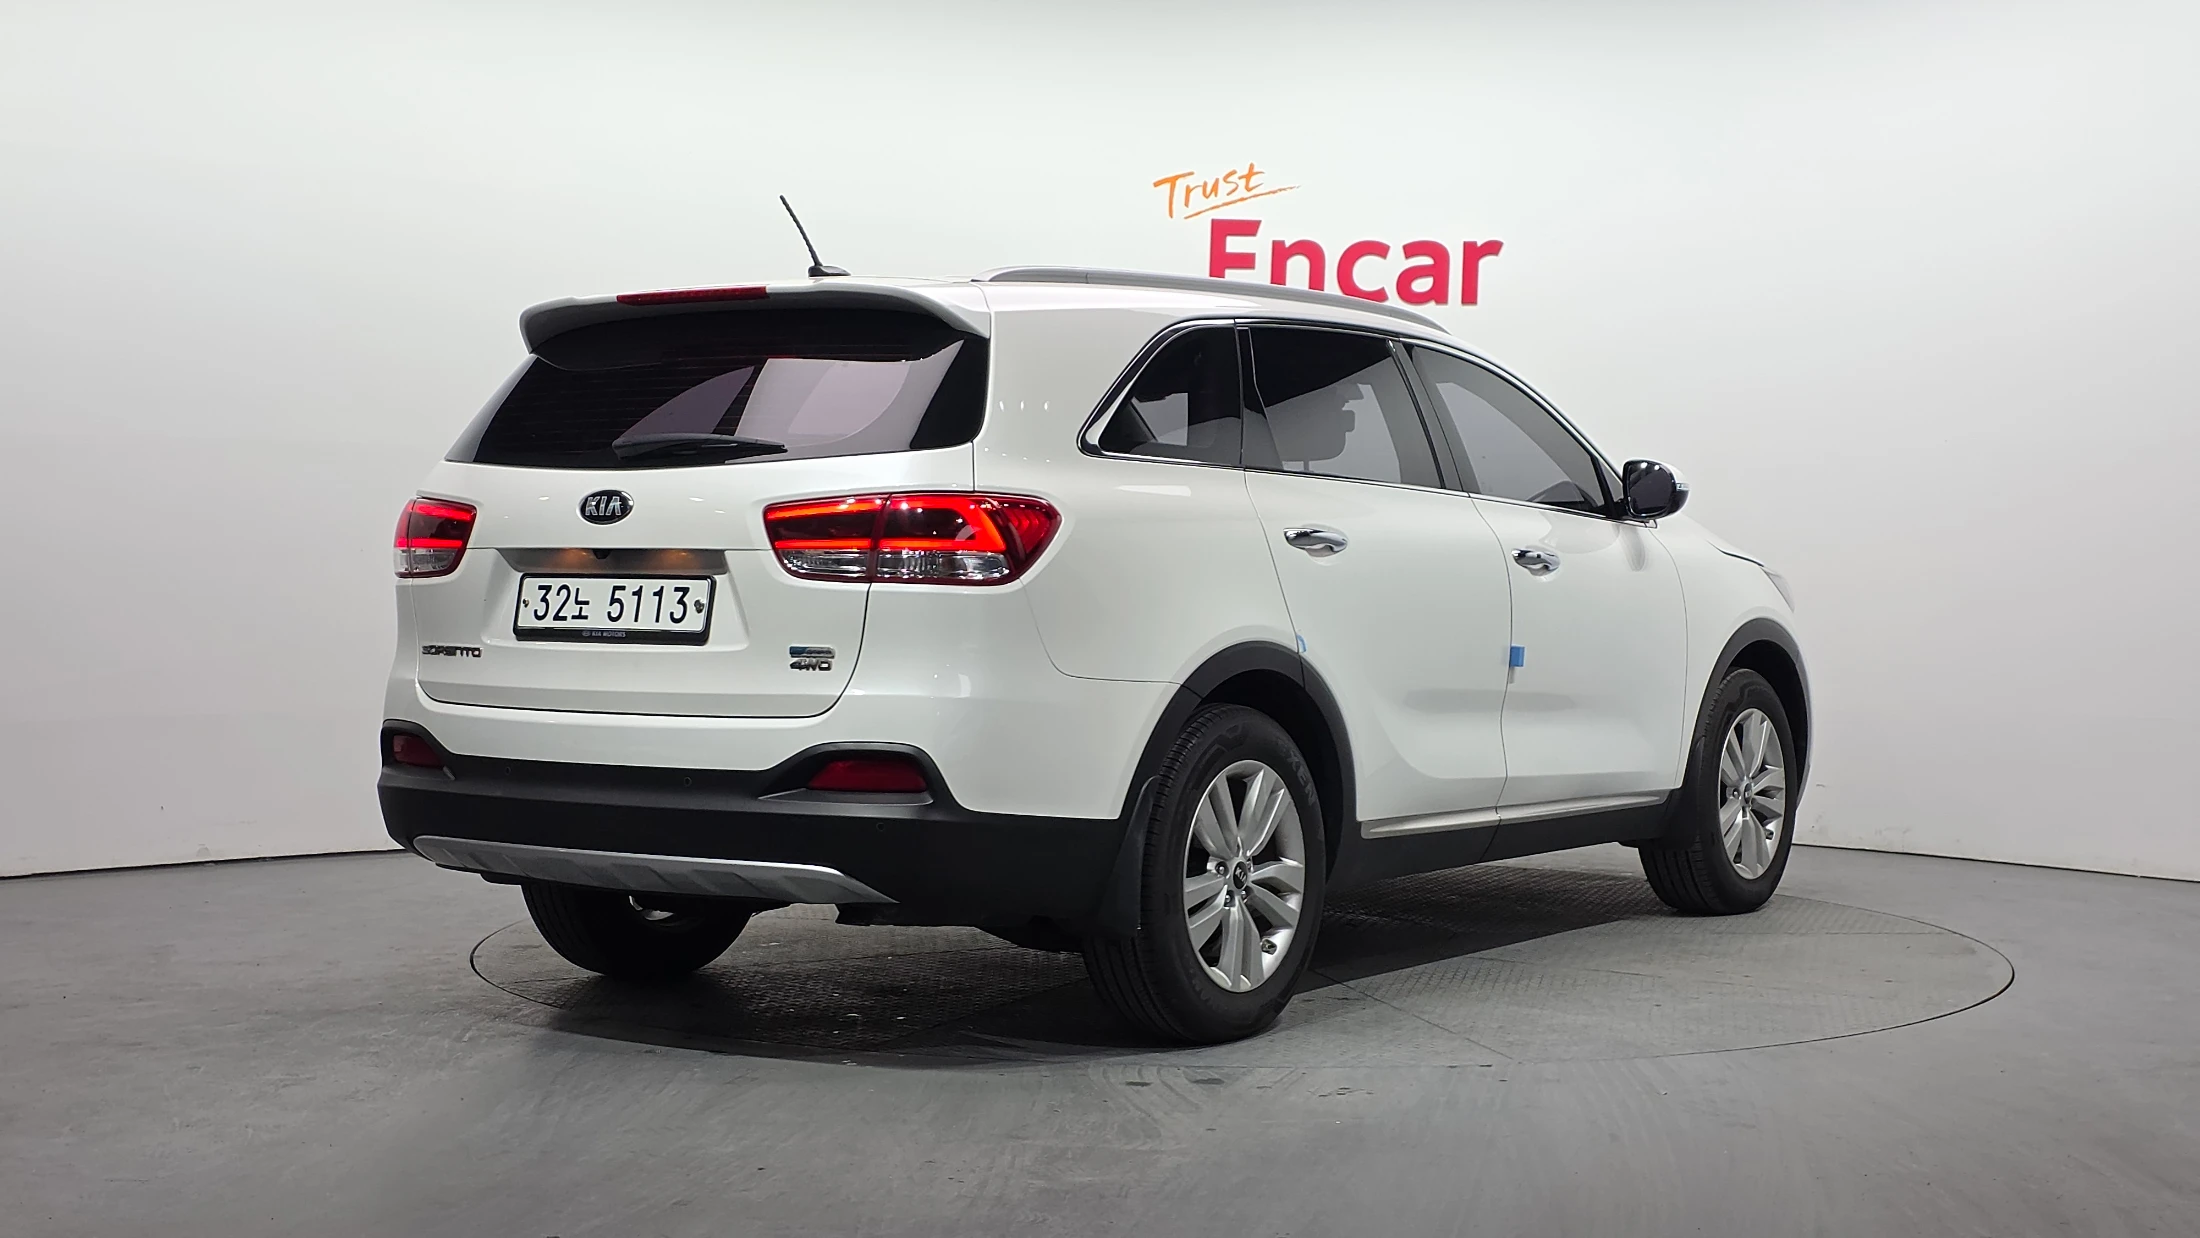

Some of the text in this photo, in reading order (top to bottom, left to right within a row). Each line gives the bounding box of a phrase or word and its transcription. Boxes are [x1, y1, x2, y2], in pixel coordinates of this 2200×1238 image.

[1153, 162, 1265, 219] Trust
[584, 495, 622, 516] KIA
[533, 584, 691, 624] 32노 5113
